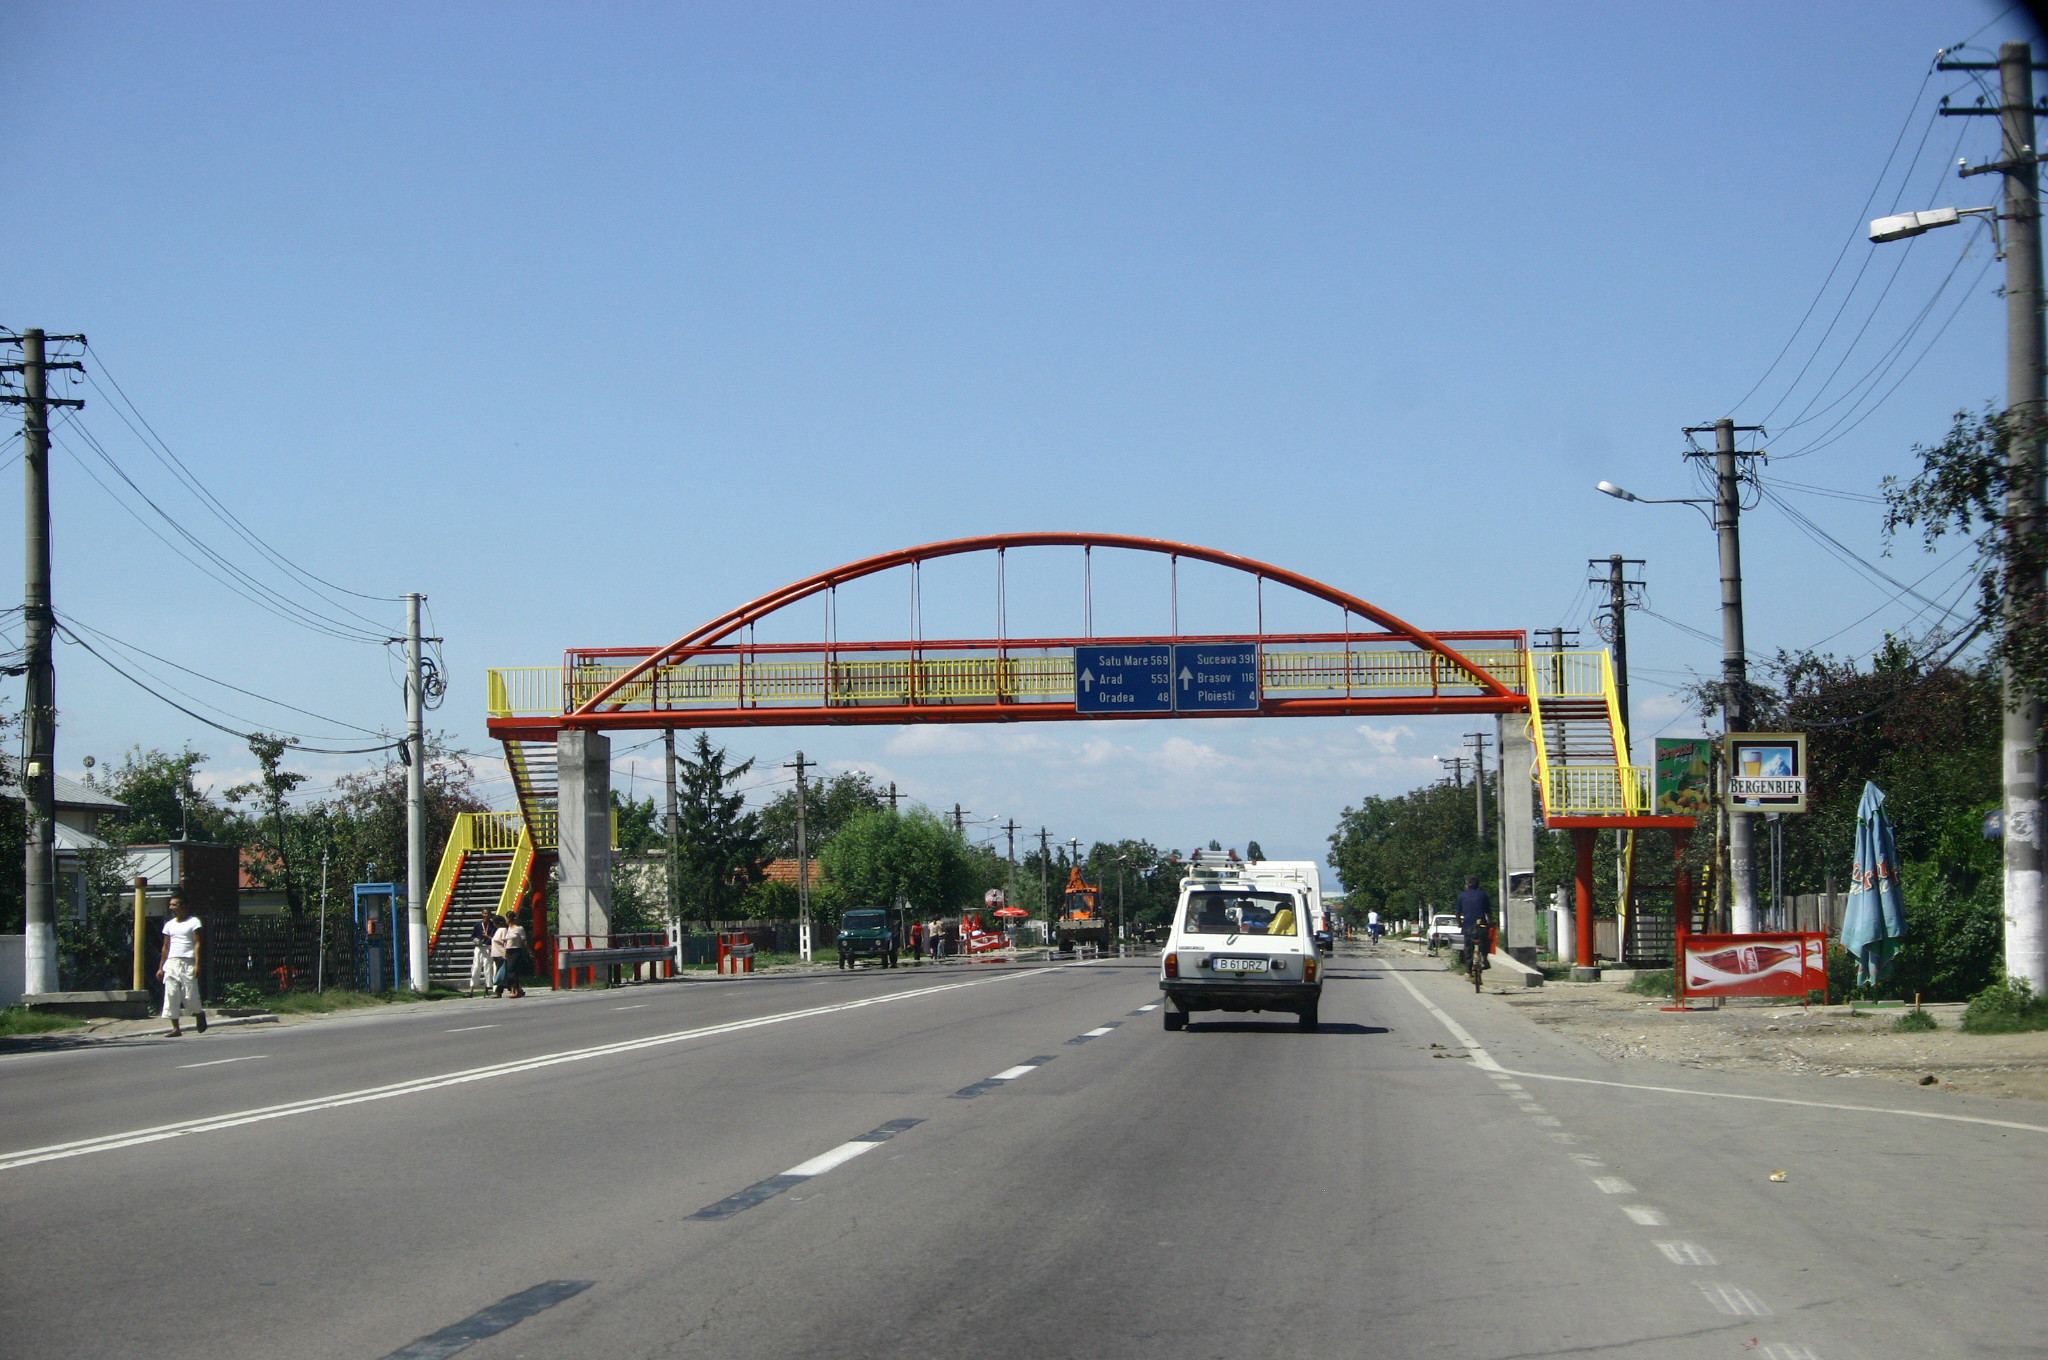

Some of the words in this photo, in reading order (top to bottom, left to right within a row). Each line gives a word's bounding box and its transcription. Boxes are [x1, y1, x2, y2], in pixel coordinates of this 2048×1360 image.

[1099, 655, 1121, 666] Satu
[1124, 656, 1148, 666] Mare
[1150, 655, 1168, 666] 569
[1197, 654, 1237, 665] Suceava
[1238, 654, 1254, 664] 391
[1099, 674, 1123, 685] Arad
[1151, 674, 1169, 684] 553
[1241, 673, 1255, 683] 116
[1099, 691, 1135, 703] Oradea
[1157, 692, 1169, 702] 48
[1249, 691, 1255, 701] 4
[1730, 778, 1802, 794] BERGENBIER
[1220, 959, 1227, 969] B
[1230, 960, 1239, 969] 61
[1242, 960, 1262, 970] DRZ
